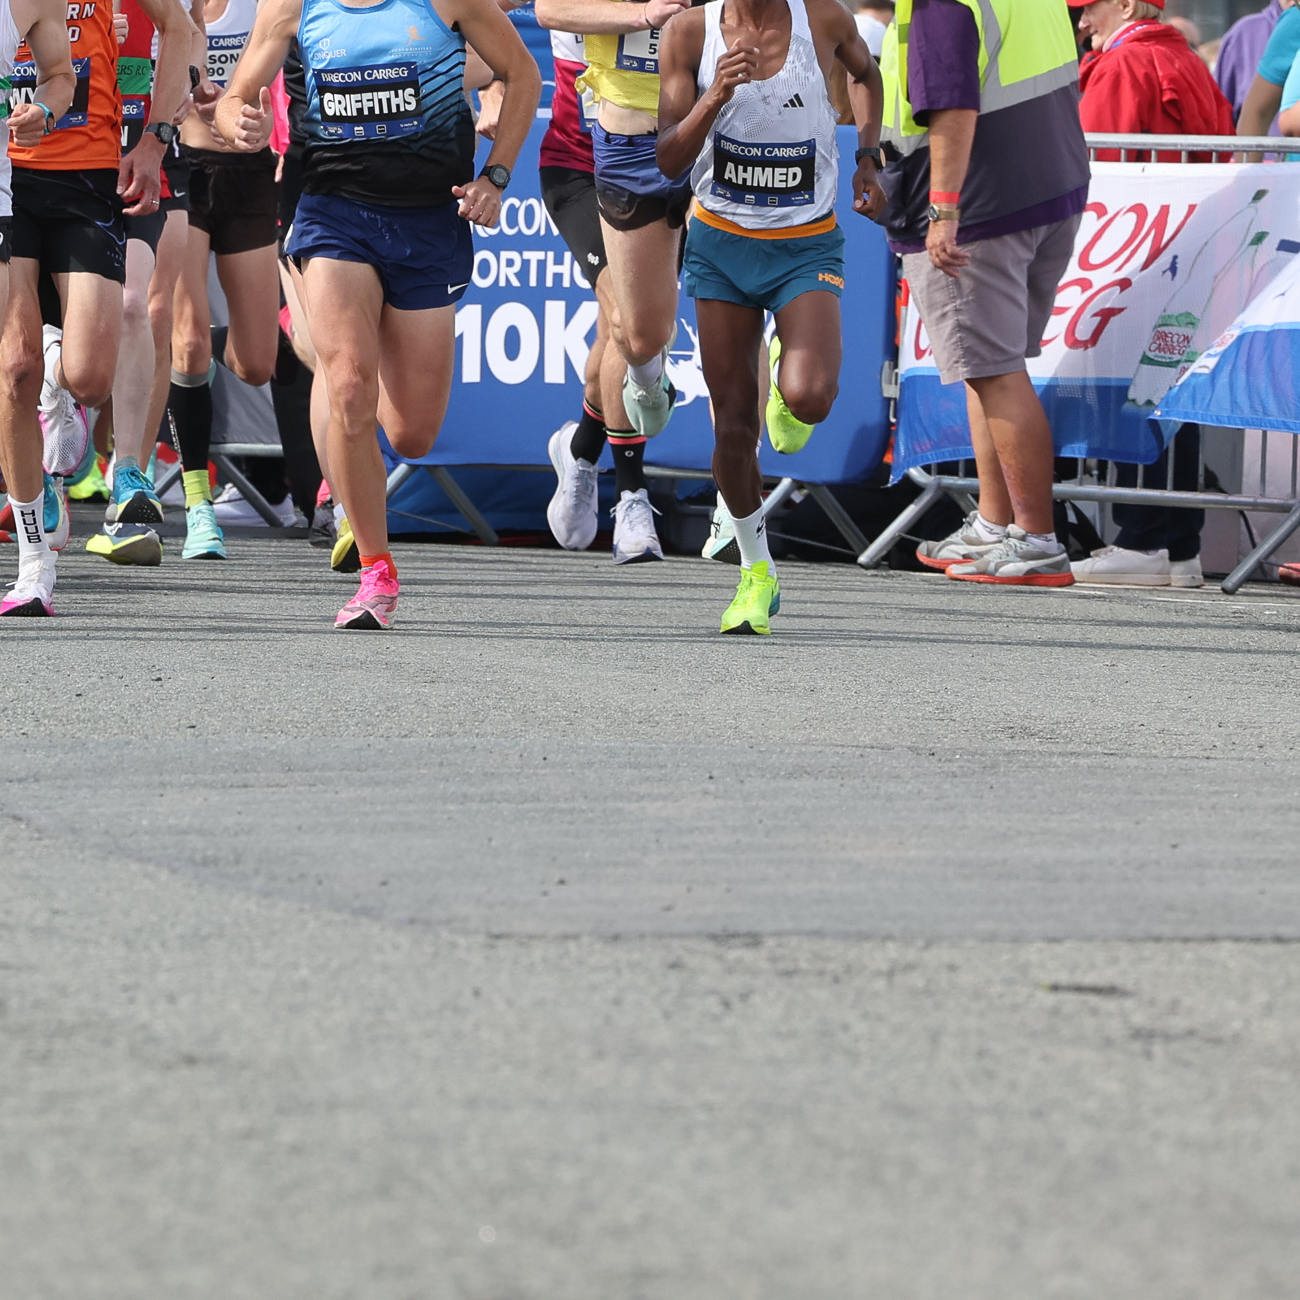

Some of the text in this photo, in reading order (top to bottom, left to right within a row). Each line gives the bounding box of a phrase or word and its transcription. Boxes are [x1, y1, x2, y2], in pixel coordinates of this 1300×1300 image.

[321, 67, 409, 83] BRECON CARREG
[323, 88, 417, 116] GRIFFITHS
[720, 140, 808, 157] BRECON CARREG
[723, 161, 802, 188] AHMED
[454, 300, 600, 385] 10K
[1148, 341, 1188, 355] CARREG
[1153, 330, 1193, 346] BRECON
[20, 509, 42, 543] HUUB
